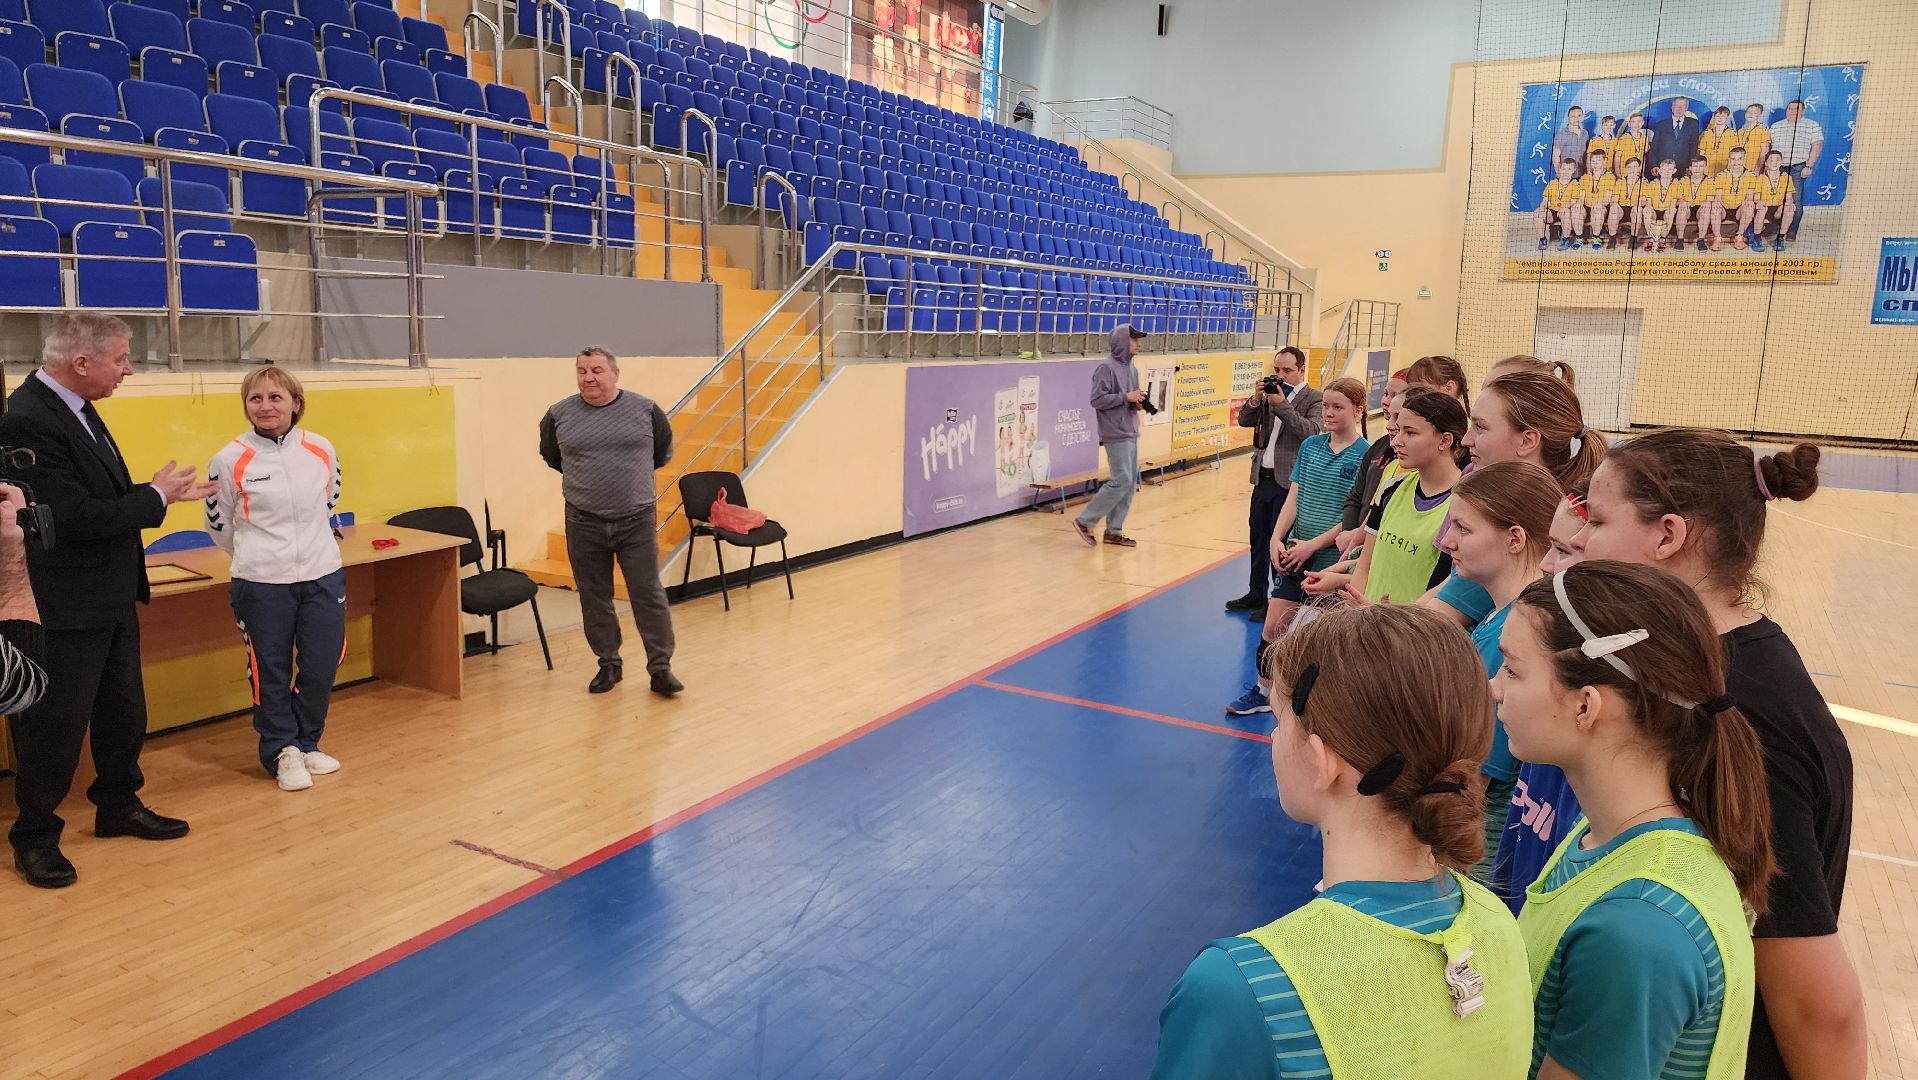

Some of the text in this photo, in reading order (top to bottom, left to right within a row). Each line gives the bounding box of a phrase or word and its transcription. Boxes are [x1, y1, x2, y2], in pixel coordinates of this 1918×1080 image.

[1615, 259, 1647, 267] России
[1663, 259, 1706, 268] гандболу
[1708, 260, 1737, 268] среди
[1740, 259, 1780, 267] юношей
[1782, 259, 1804, 267] 2003
[1593, 267, 1623, 275] Совета
[1692, 267, 1741, 276] Егорьевск
[921, 414, 977, 481] Happy
[246, 474, 271, 484] hummel
